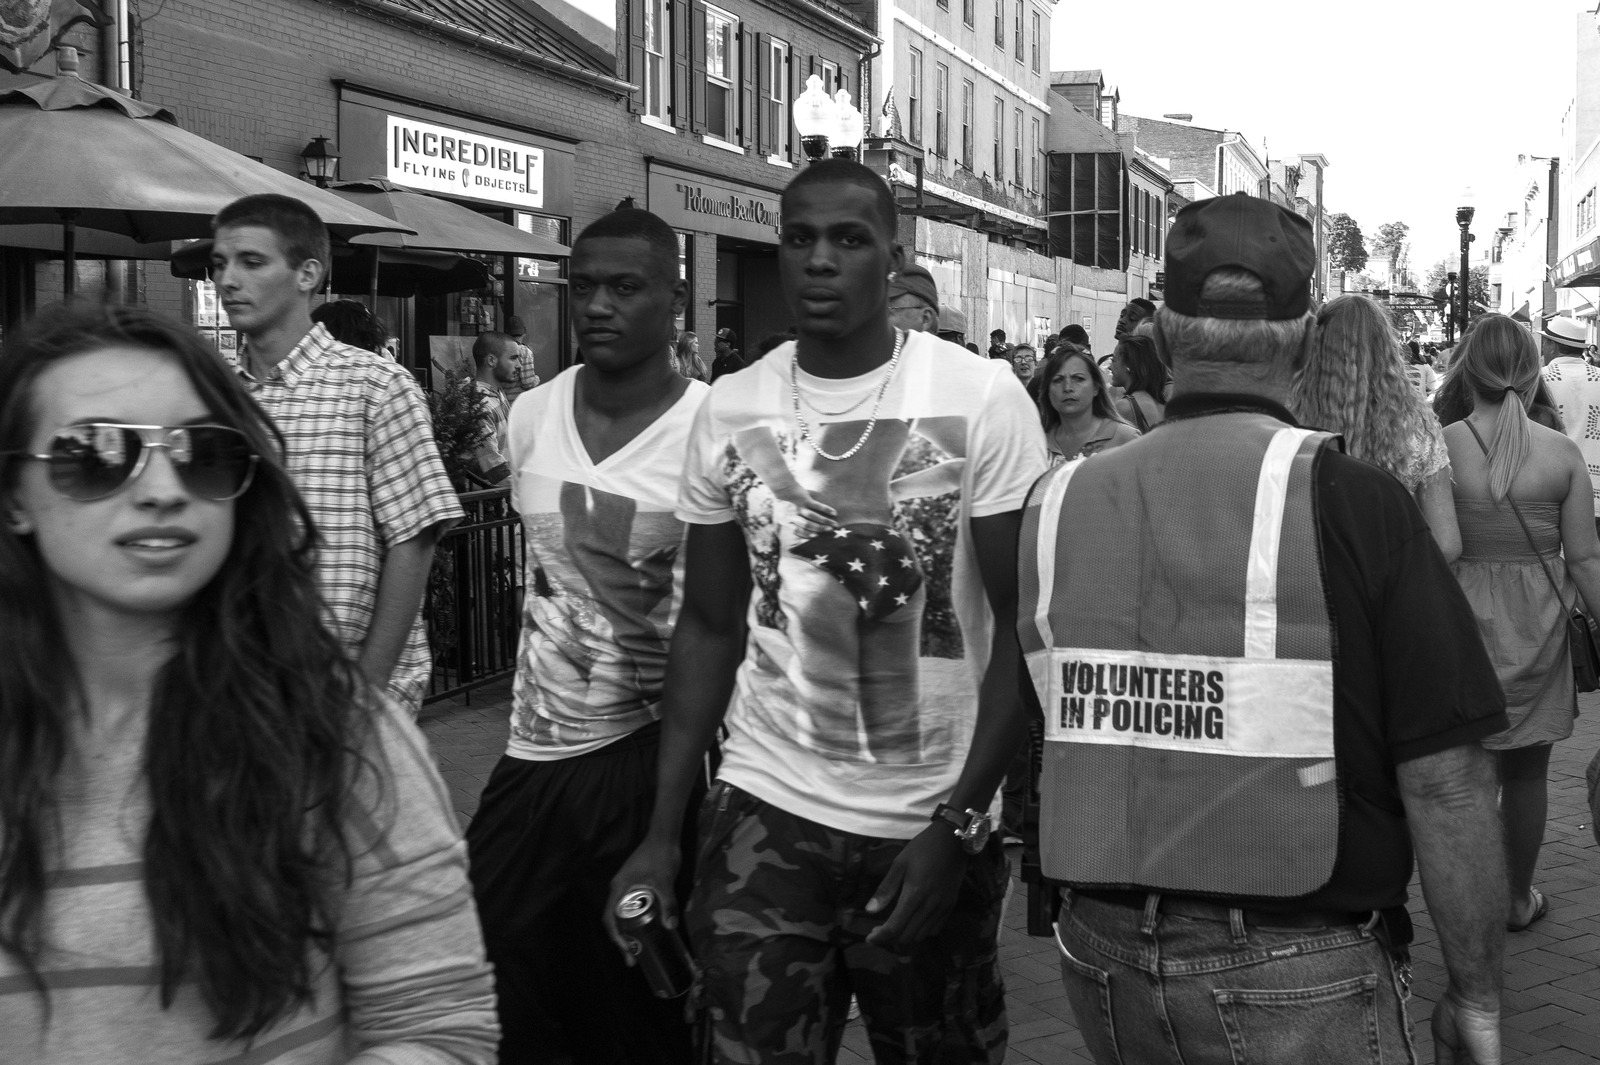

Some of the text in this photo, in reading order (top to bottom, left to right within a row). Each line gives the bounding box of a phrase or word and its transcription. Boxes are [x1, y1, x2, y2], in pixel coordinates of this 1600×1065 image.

[394, 125, 538, 194] INCREDIBLE
[404, 161, 526, 193] FLYING OBJECTS
[684, 185, 731, 218] Potomac
[730, 195, 755, 222] Bead
[1061, 660, 1225, 704] VOLUNTEERS
[1060, 697, 1225, 740] IN POLICING
